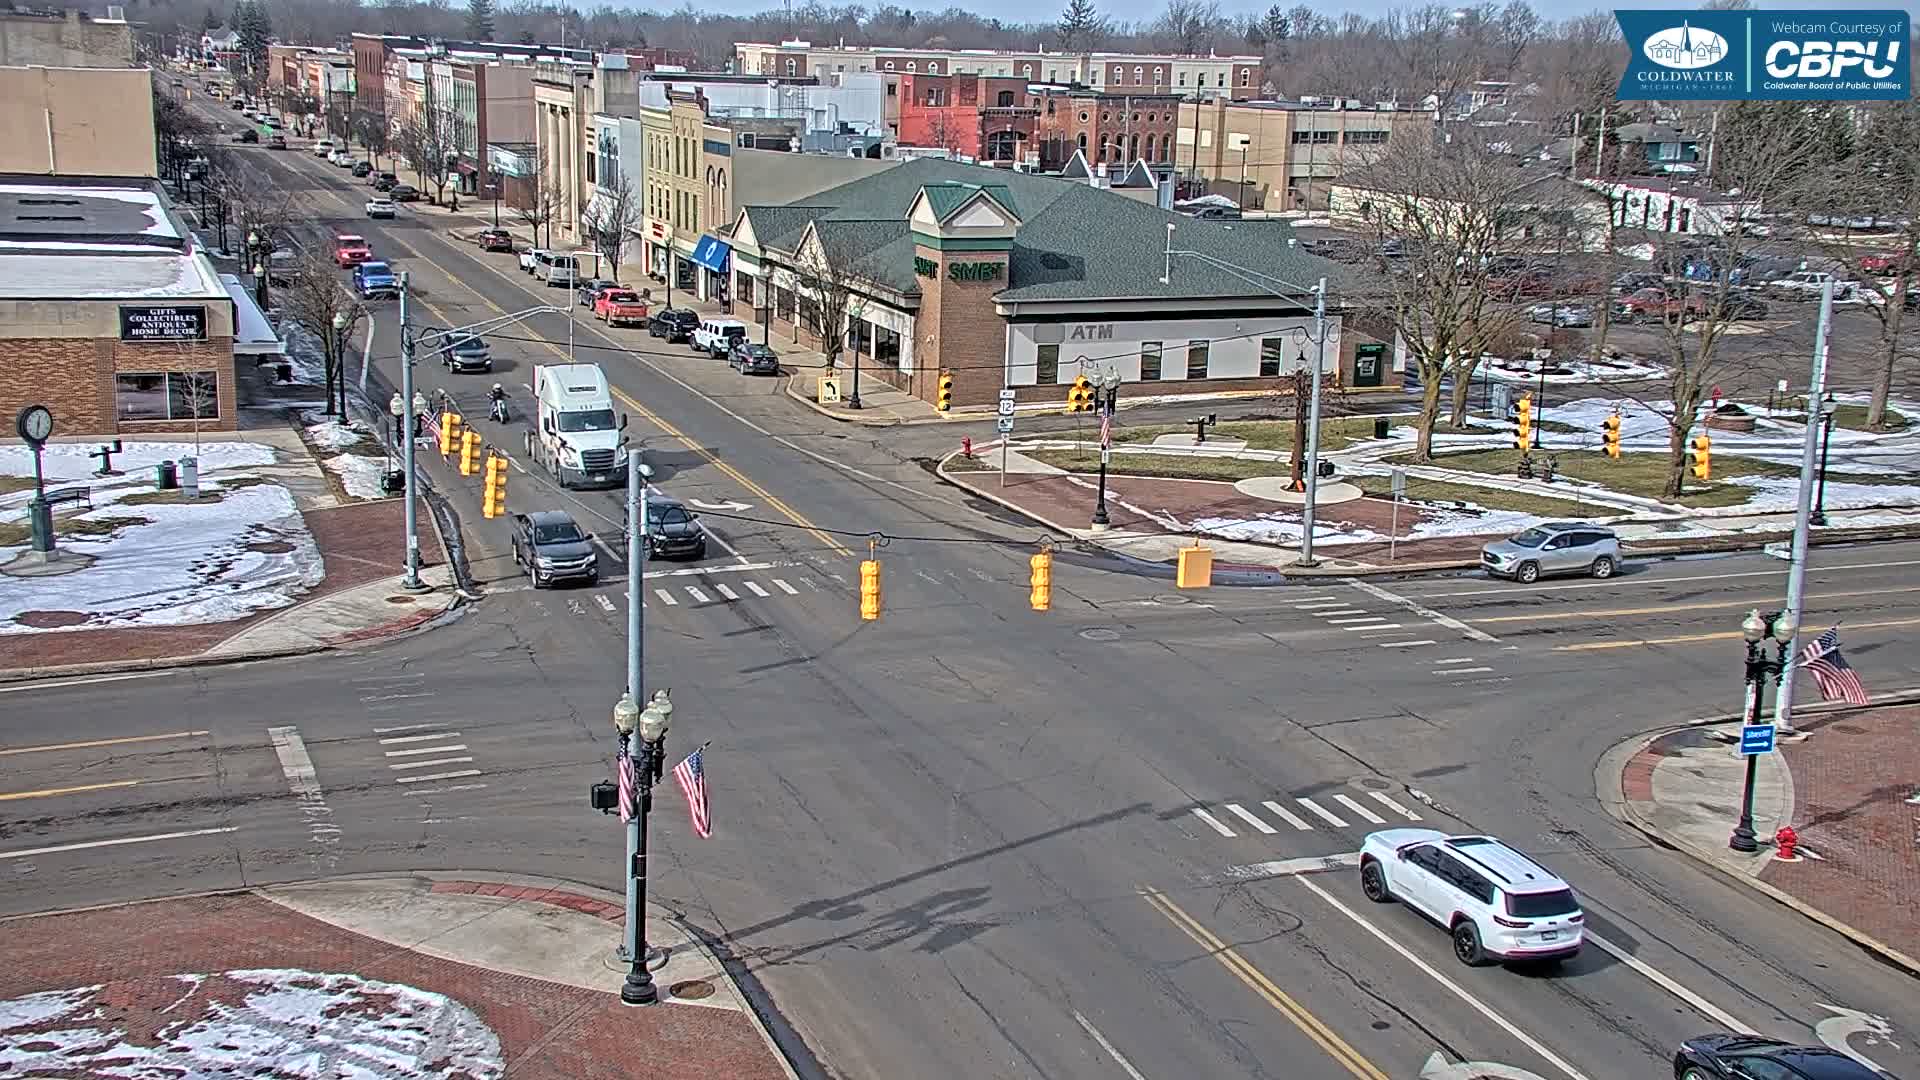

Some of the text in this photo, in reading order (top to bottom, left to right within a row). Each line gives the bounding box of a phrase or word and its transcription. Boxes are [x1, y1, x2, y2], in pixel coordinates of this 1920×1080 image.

[948, 262, 1006, 281] SMBT
[149, 308, 177, 316] GIFTS
[141, 321, 187, 329] ANTIQUES
[131, 328, 160, 336] HOME
[1070, 323, 1113, 340] ATM
[1002, 402, 1012, 412] 12
